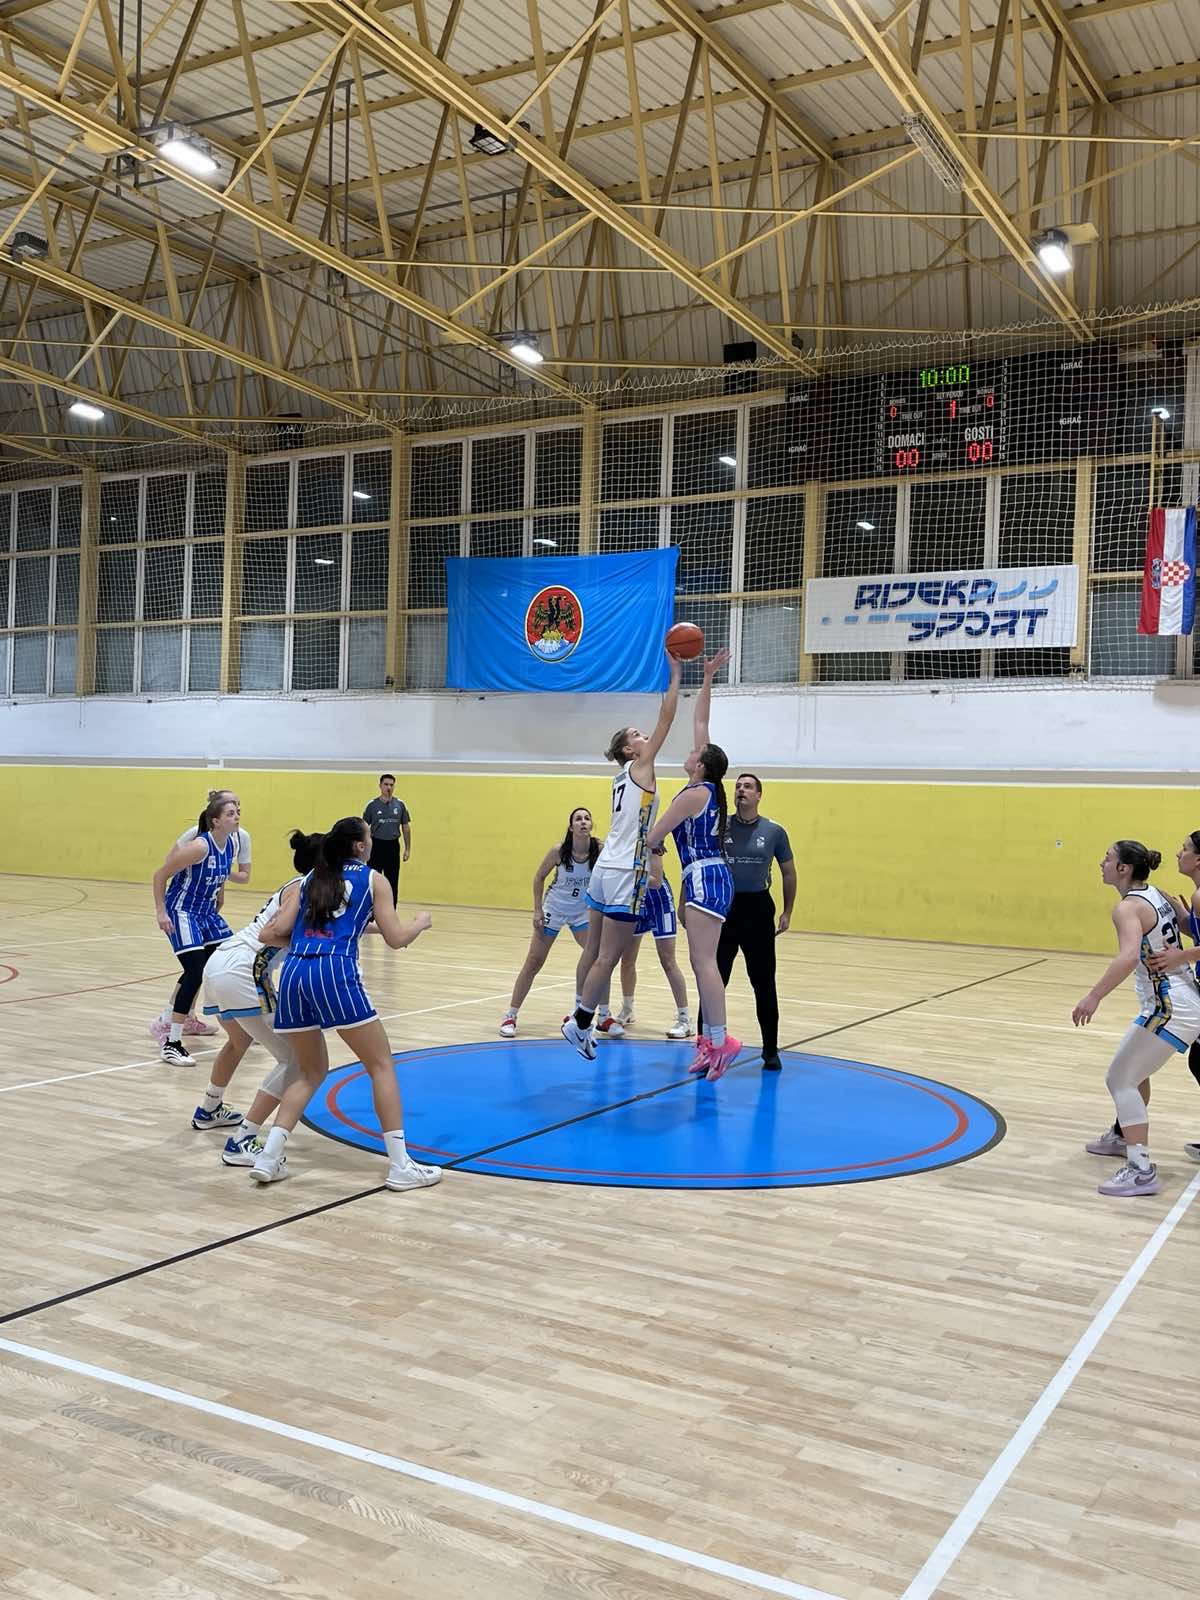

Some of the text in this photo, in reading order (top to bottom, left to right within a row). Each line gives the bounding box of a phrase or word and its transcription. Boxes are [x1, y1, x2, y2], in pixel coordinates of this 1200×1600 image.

[920, 364, 970, 388] 10:00
[949, 399, 957, 419] 1
[986, 394, 994, 408] 0
[890, 406, 898, 418] 0
[964, 425, 994, 442] GOSTI
[895, 448, 919, 468] 00
[968, 440, 993, 461] 00
[855, 578, 998, 610] RIJEKA
[908, 608, 1049, 642] SPORT
[612, 783, 626, 813] 17
[572, 888, 580, 897] 6
